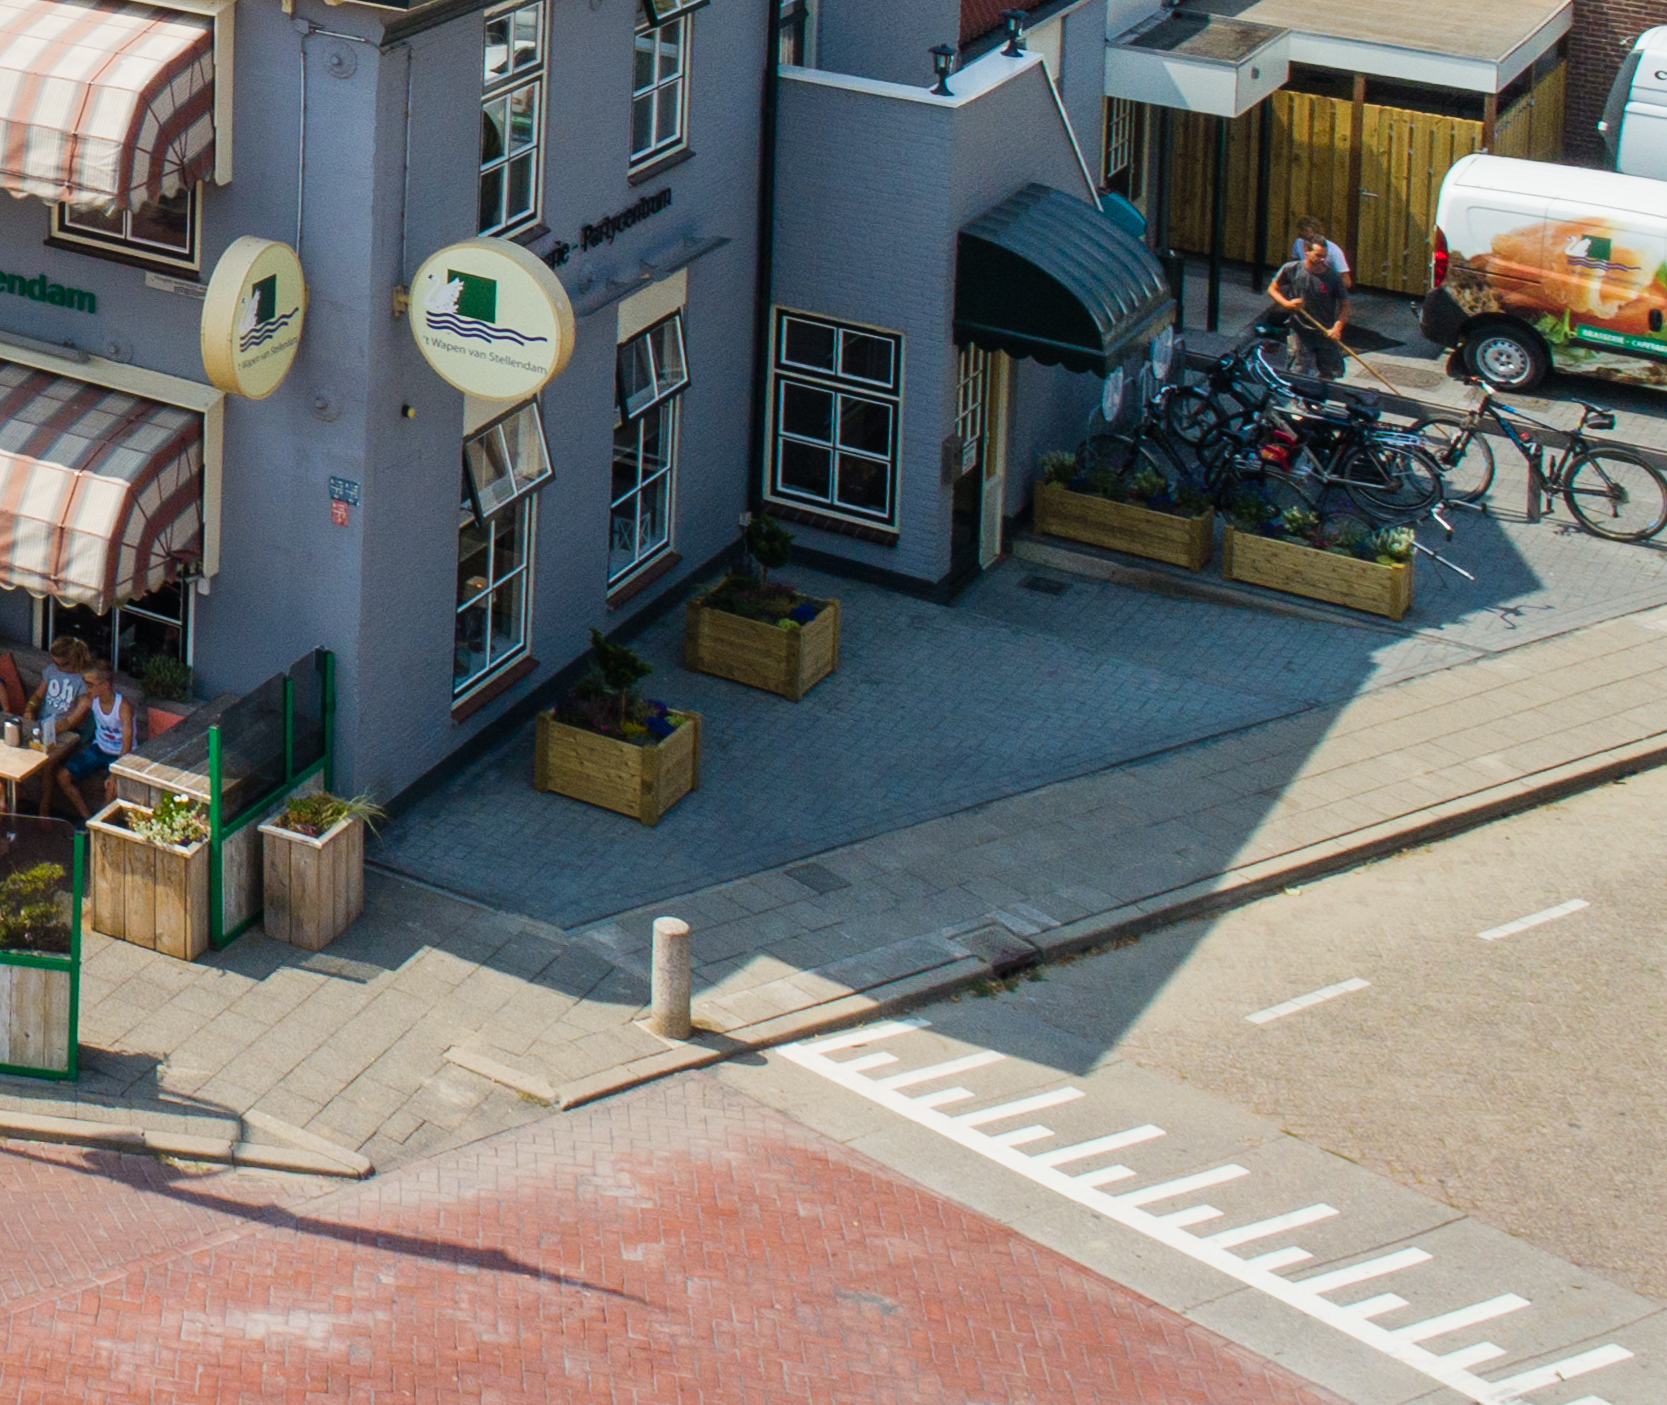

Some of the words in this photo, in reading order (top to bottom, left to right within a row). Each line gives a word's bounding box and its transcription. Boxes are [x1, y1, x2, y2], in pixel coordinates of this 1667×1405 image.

[431, 337, 466, 353] Wapen
[468, 348, 487, 360] van
[488, 352, 547, 375] Stellendam
[47, 678, 74, 704] oh
